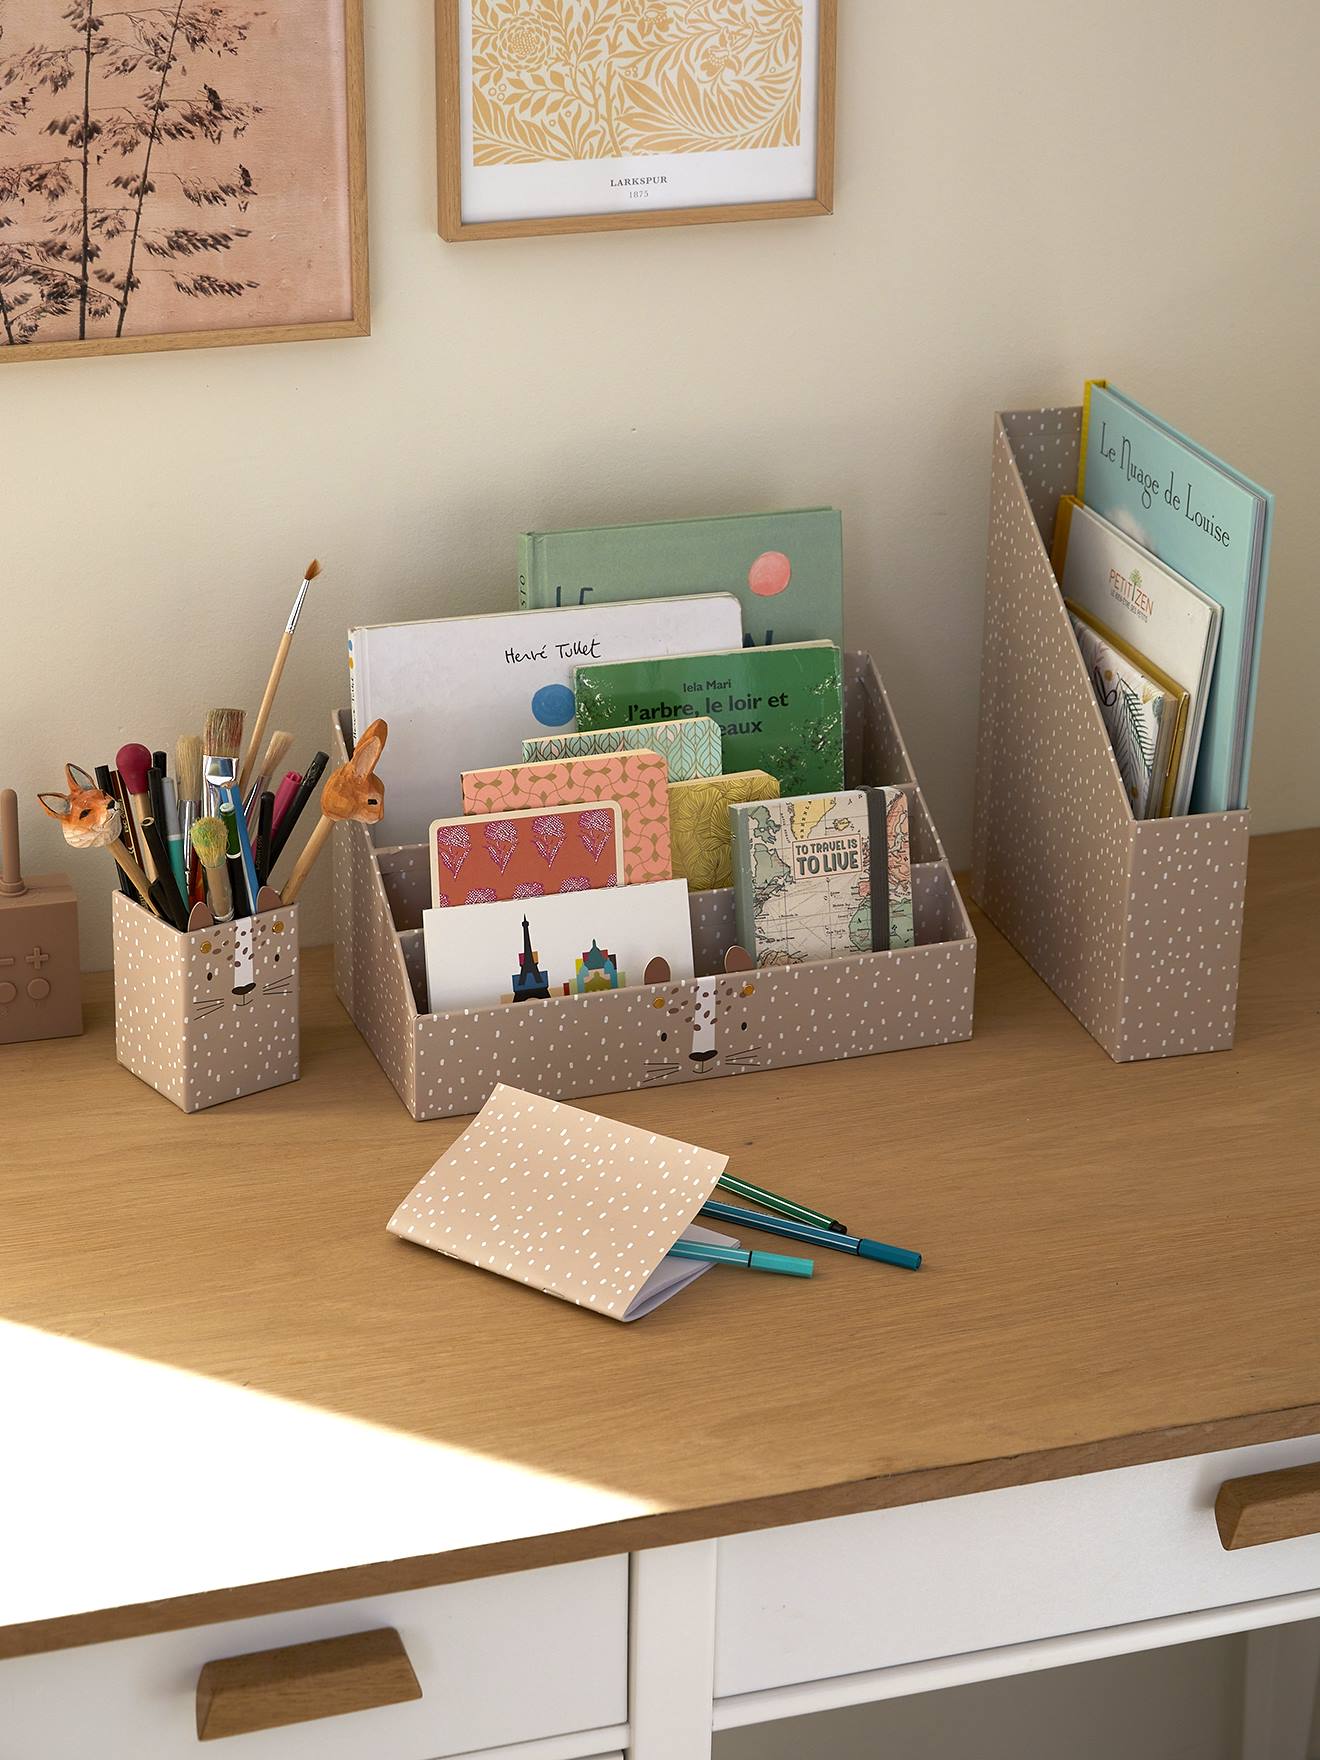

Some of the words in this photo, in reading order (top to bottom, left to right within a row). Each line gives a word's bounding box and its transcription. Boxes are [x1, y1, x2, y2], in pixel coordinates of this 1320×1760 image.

[610, 176, 667, 187] LARKSPUR
[629, 190, 649, 198] 1875
[1100, 421, 1116, 462] Le
[1120, 435, 1159, 509] Nuage
[1164, 471, 1180, 510] de
[1185, 483, 1230, 547] Louise
[505, 645, 548, 664] Hervé
[555, 638, 601, 659] Tullet
[683, 683, 703, 693] Iela
[706, 679, 732, 690] Mari
[706, 697, 722, 713] le
[729, 694, 762, 711] loir
[767, 692, 789, 707] et
[719, 720, 763, 736] eaux
[795, 845, 809, 855] TO
[810, 840, 846, 854] TRAVEL
[848, 838, 858, 849] IS
[796, 855, 820, 876] TO
[822, 850, 859, 873] LIVE
